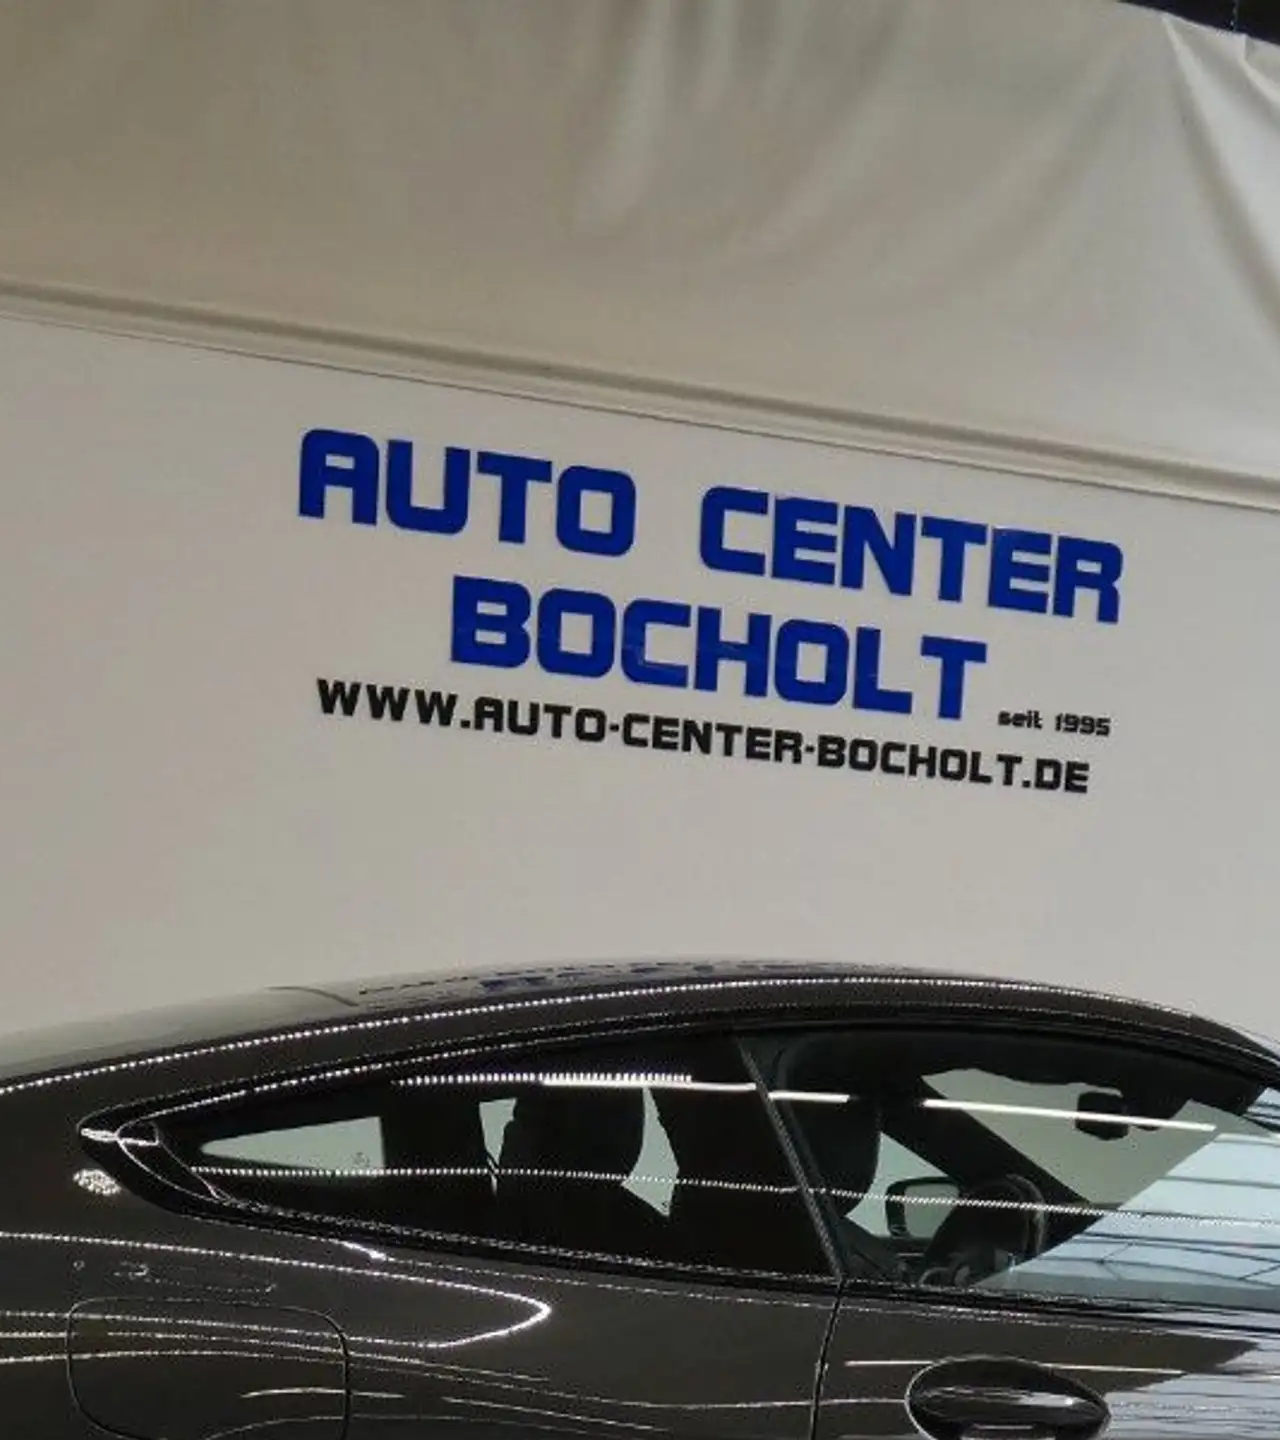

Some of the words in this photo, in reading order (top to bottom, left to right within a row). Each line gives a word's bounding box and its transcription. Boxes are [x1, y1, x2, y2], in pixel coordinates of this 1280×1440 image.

[298, 429, 637, 557] AUTO
[699, 486, 1124, 623] CENTER
[451, 575, 987, 721] BOCHOLT
[316, 678, 1090, 794] WWW.AUTO-CENTER-BOCHOLT.DE
[998, 710, 1043, 730] seit
[1055, 713, 1111, 737] 1995
